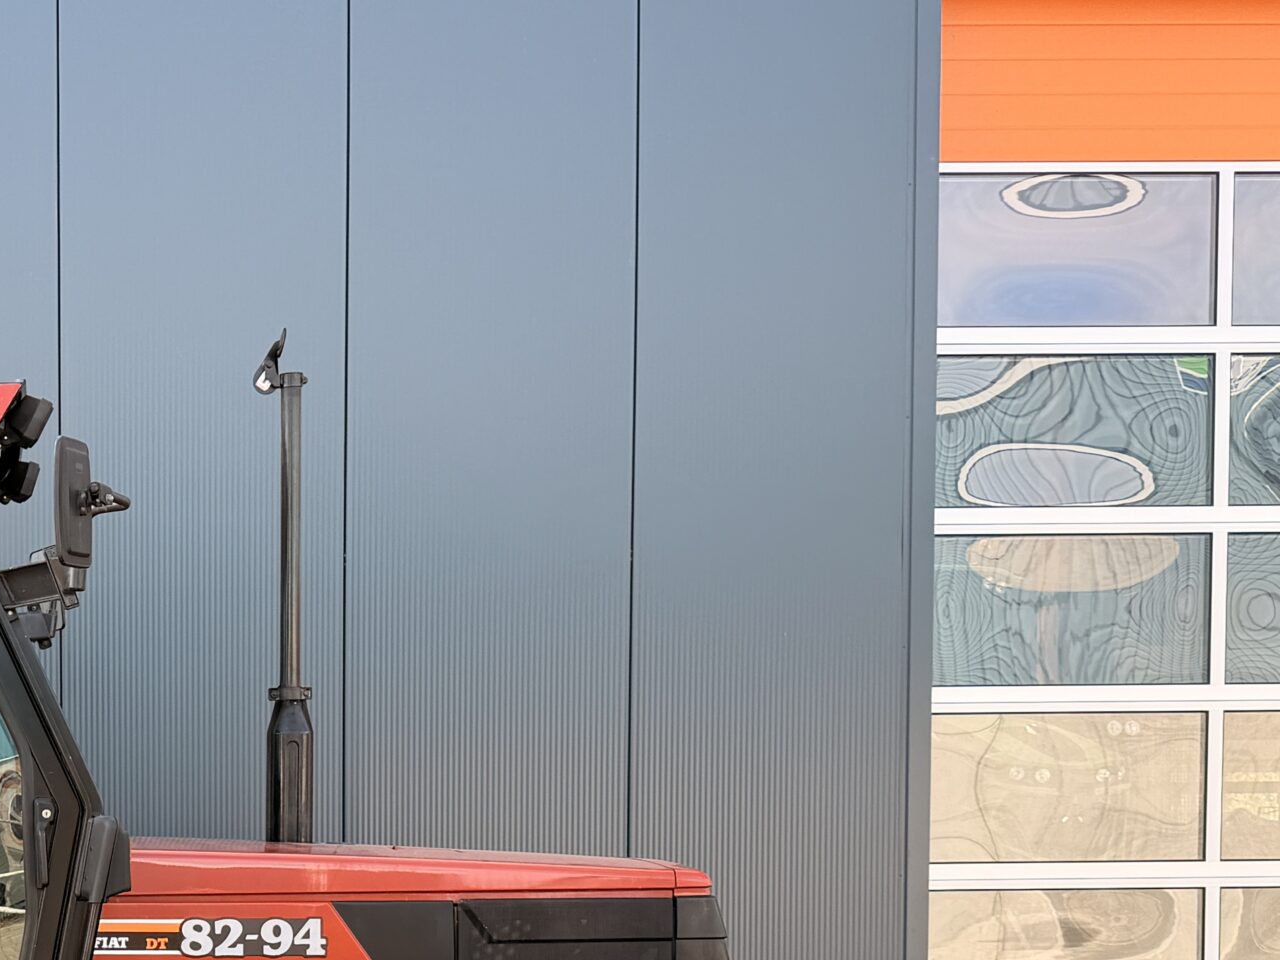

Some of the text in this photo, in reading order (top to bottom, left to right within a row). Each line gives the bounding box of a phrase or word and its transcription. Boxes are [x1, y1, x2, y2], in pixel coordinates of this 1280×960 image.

[94, 917, 327, 958] FIAT DT 82-94
